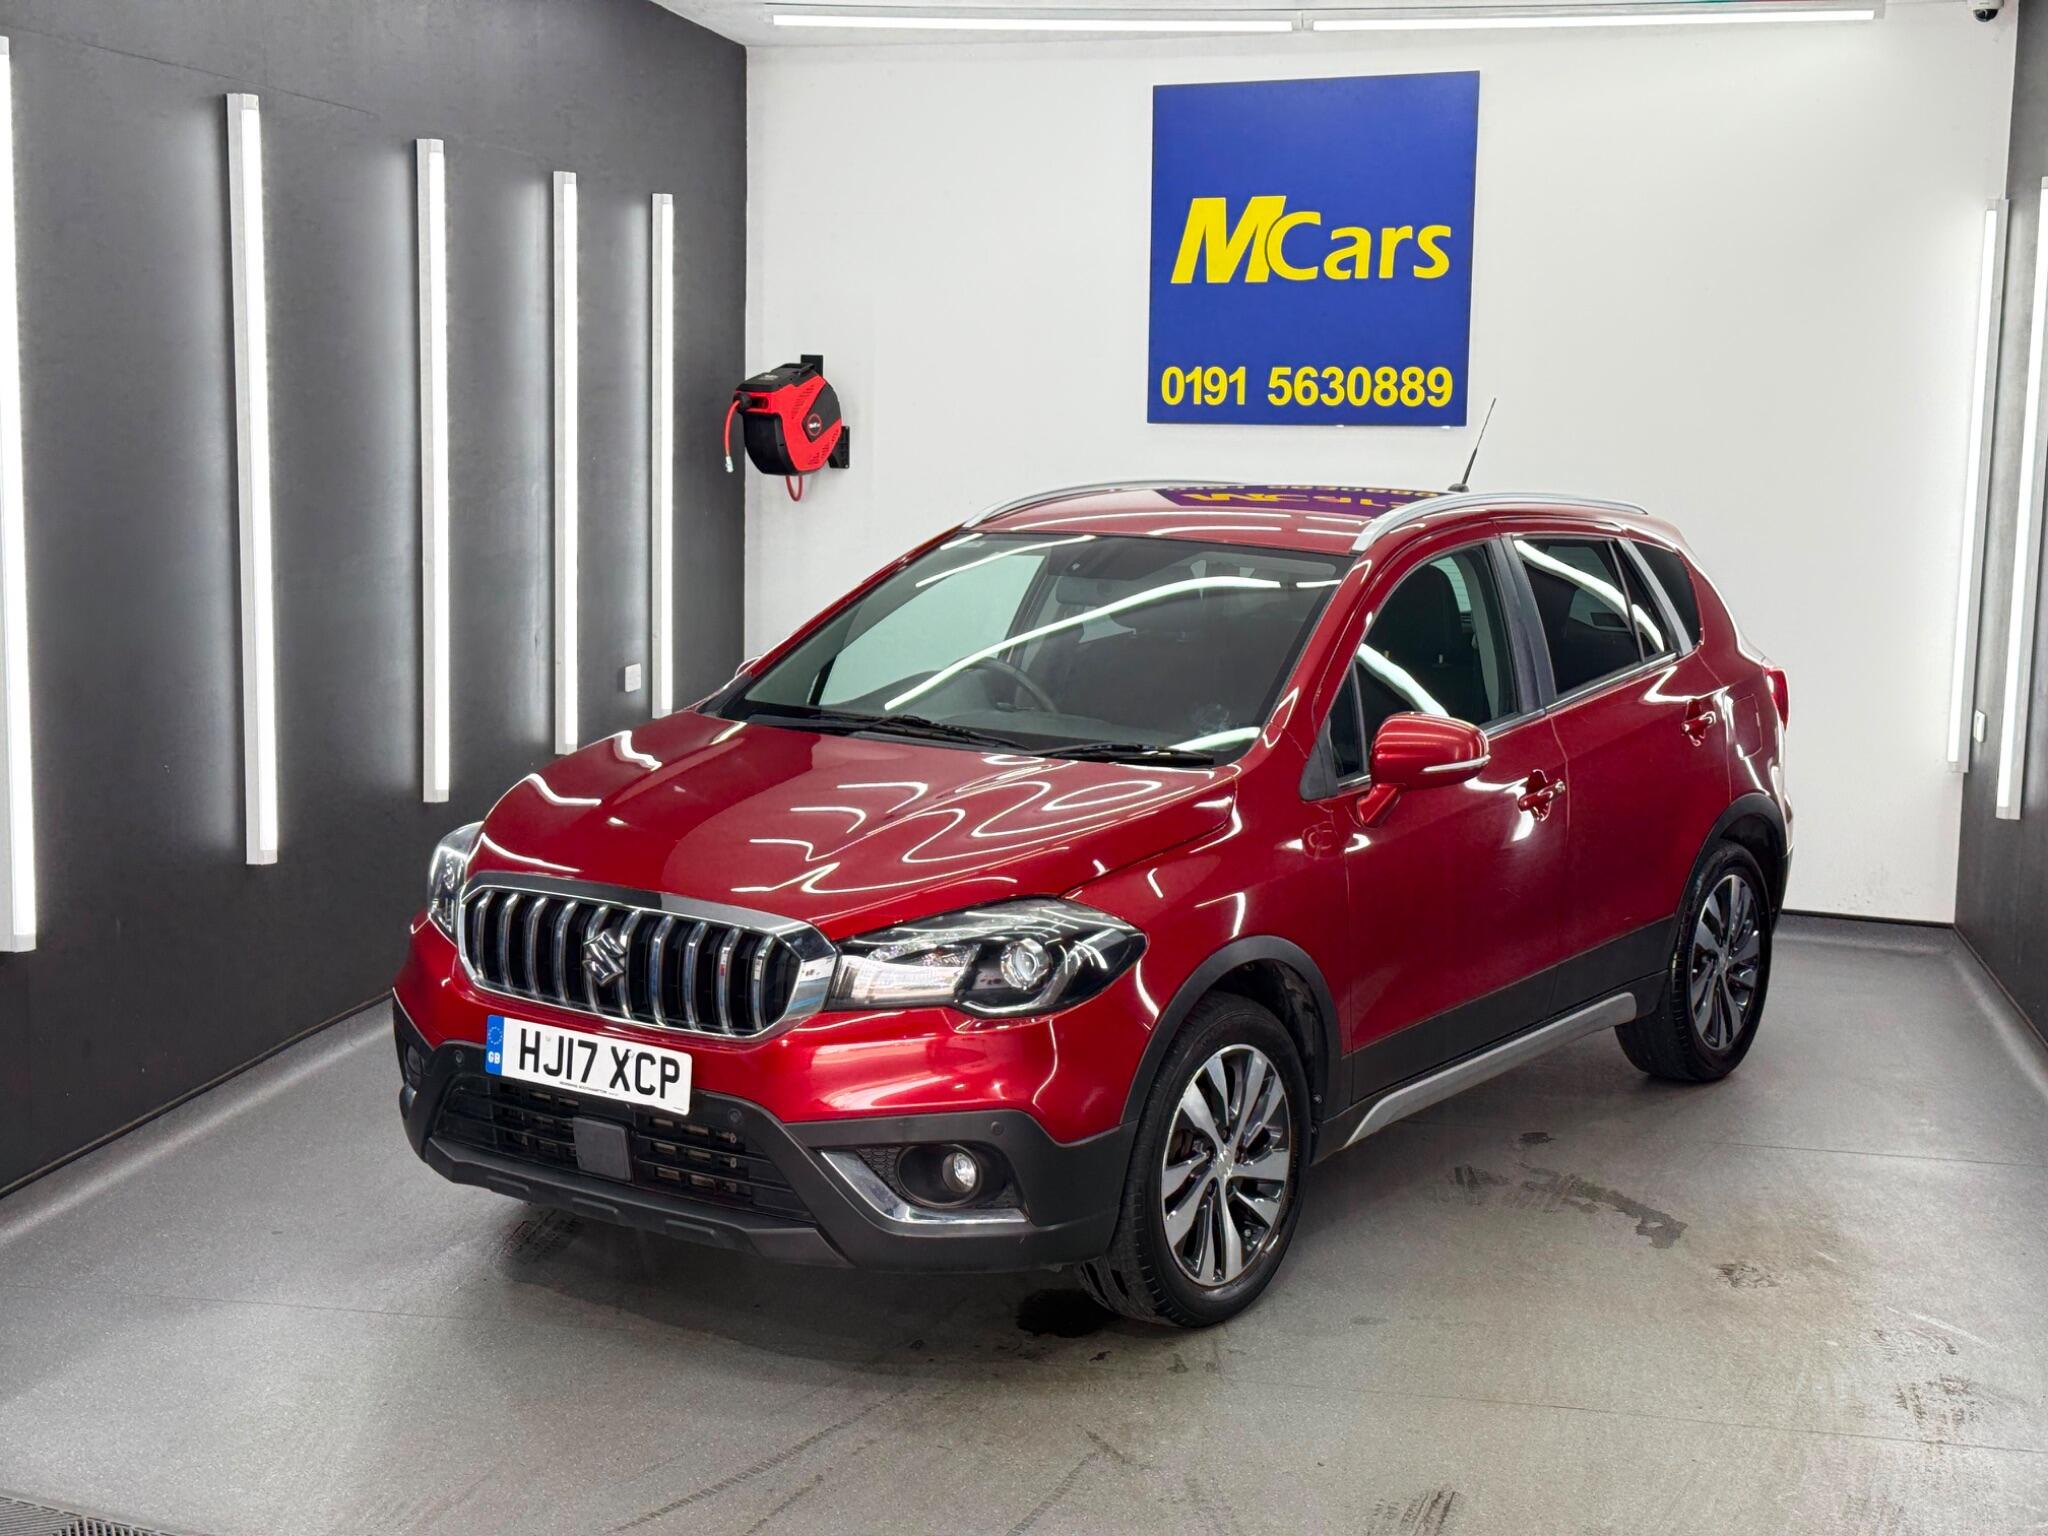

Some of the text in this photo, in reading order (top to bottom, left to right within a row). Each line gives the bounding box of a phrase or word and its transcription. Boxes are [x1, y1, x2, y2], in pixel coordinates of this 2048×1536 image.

[1171, 195, 1452, 284] MCars
[1161, 366, 1454, 407] 0191 5630889
[487, 1050, 501, 1065] GB
[519, 1028, 680, 1099] HJ17 XCP
